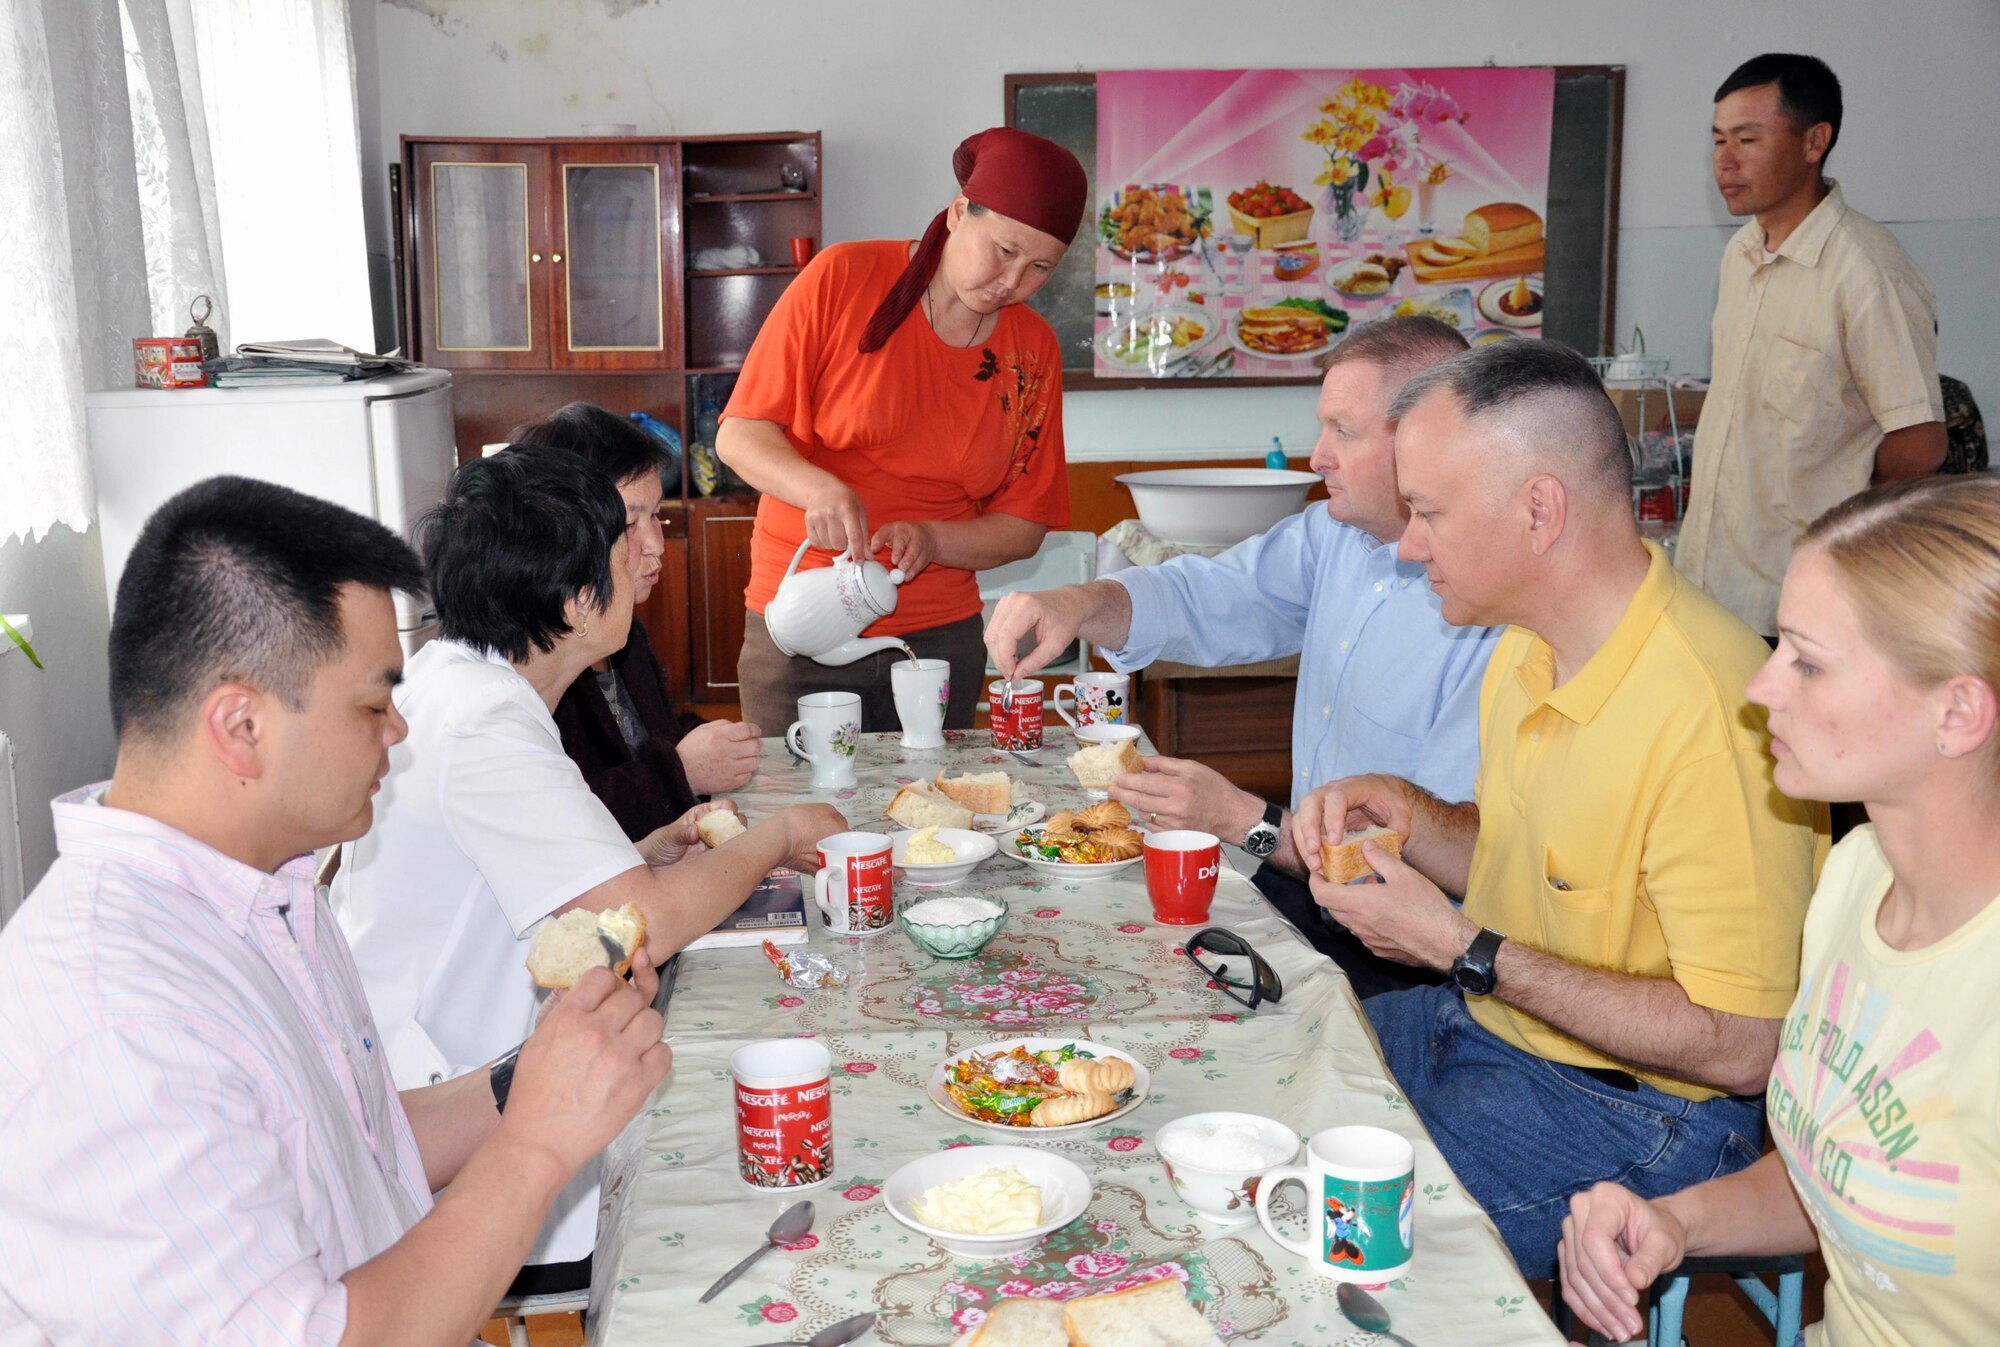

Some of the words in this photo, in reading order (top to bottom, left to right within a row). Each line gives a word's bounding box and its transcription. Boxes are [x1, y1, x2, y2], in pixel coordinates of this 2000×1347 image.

[1767, 1077, 1819, 1162] DENIM
[1819, 1136, 1856, 1204] CO.
[1809, 1018, 1863, 1083] POLO
[1851, 1064, 1919, 1173] ASSN.
